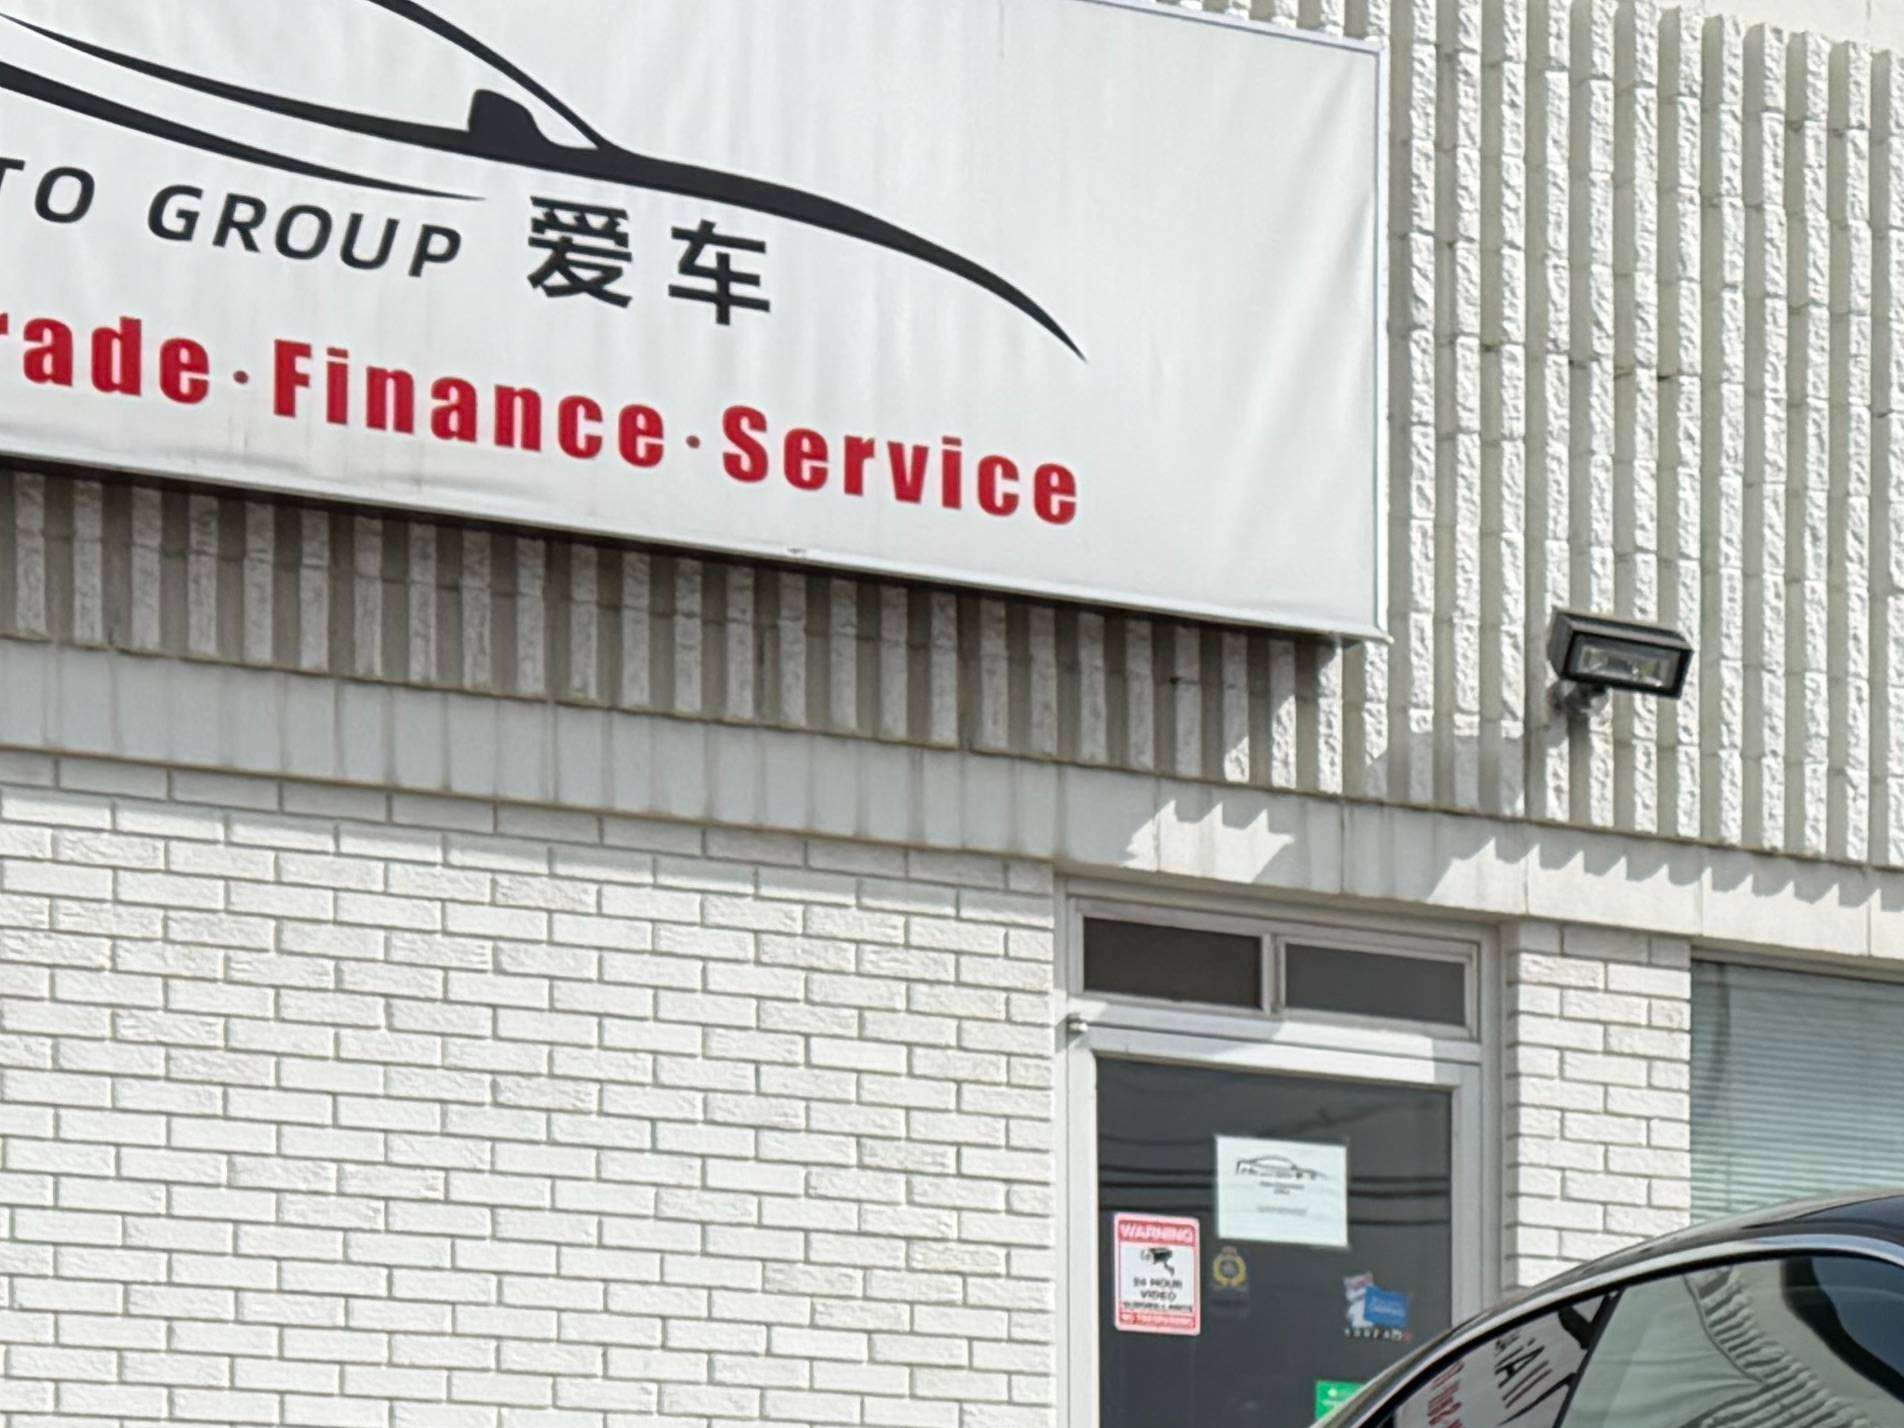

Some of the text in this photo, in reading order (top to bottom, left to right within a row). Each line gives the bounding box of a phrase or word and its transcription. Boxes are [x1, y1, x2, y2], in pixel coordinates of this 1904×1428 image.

[148, 185, 462, 277] GROUP
[527, 196, 770, 326] 爱车
[0, 313, 210, 406] ade
[721, 405, 1077, 525] Service
